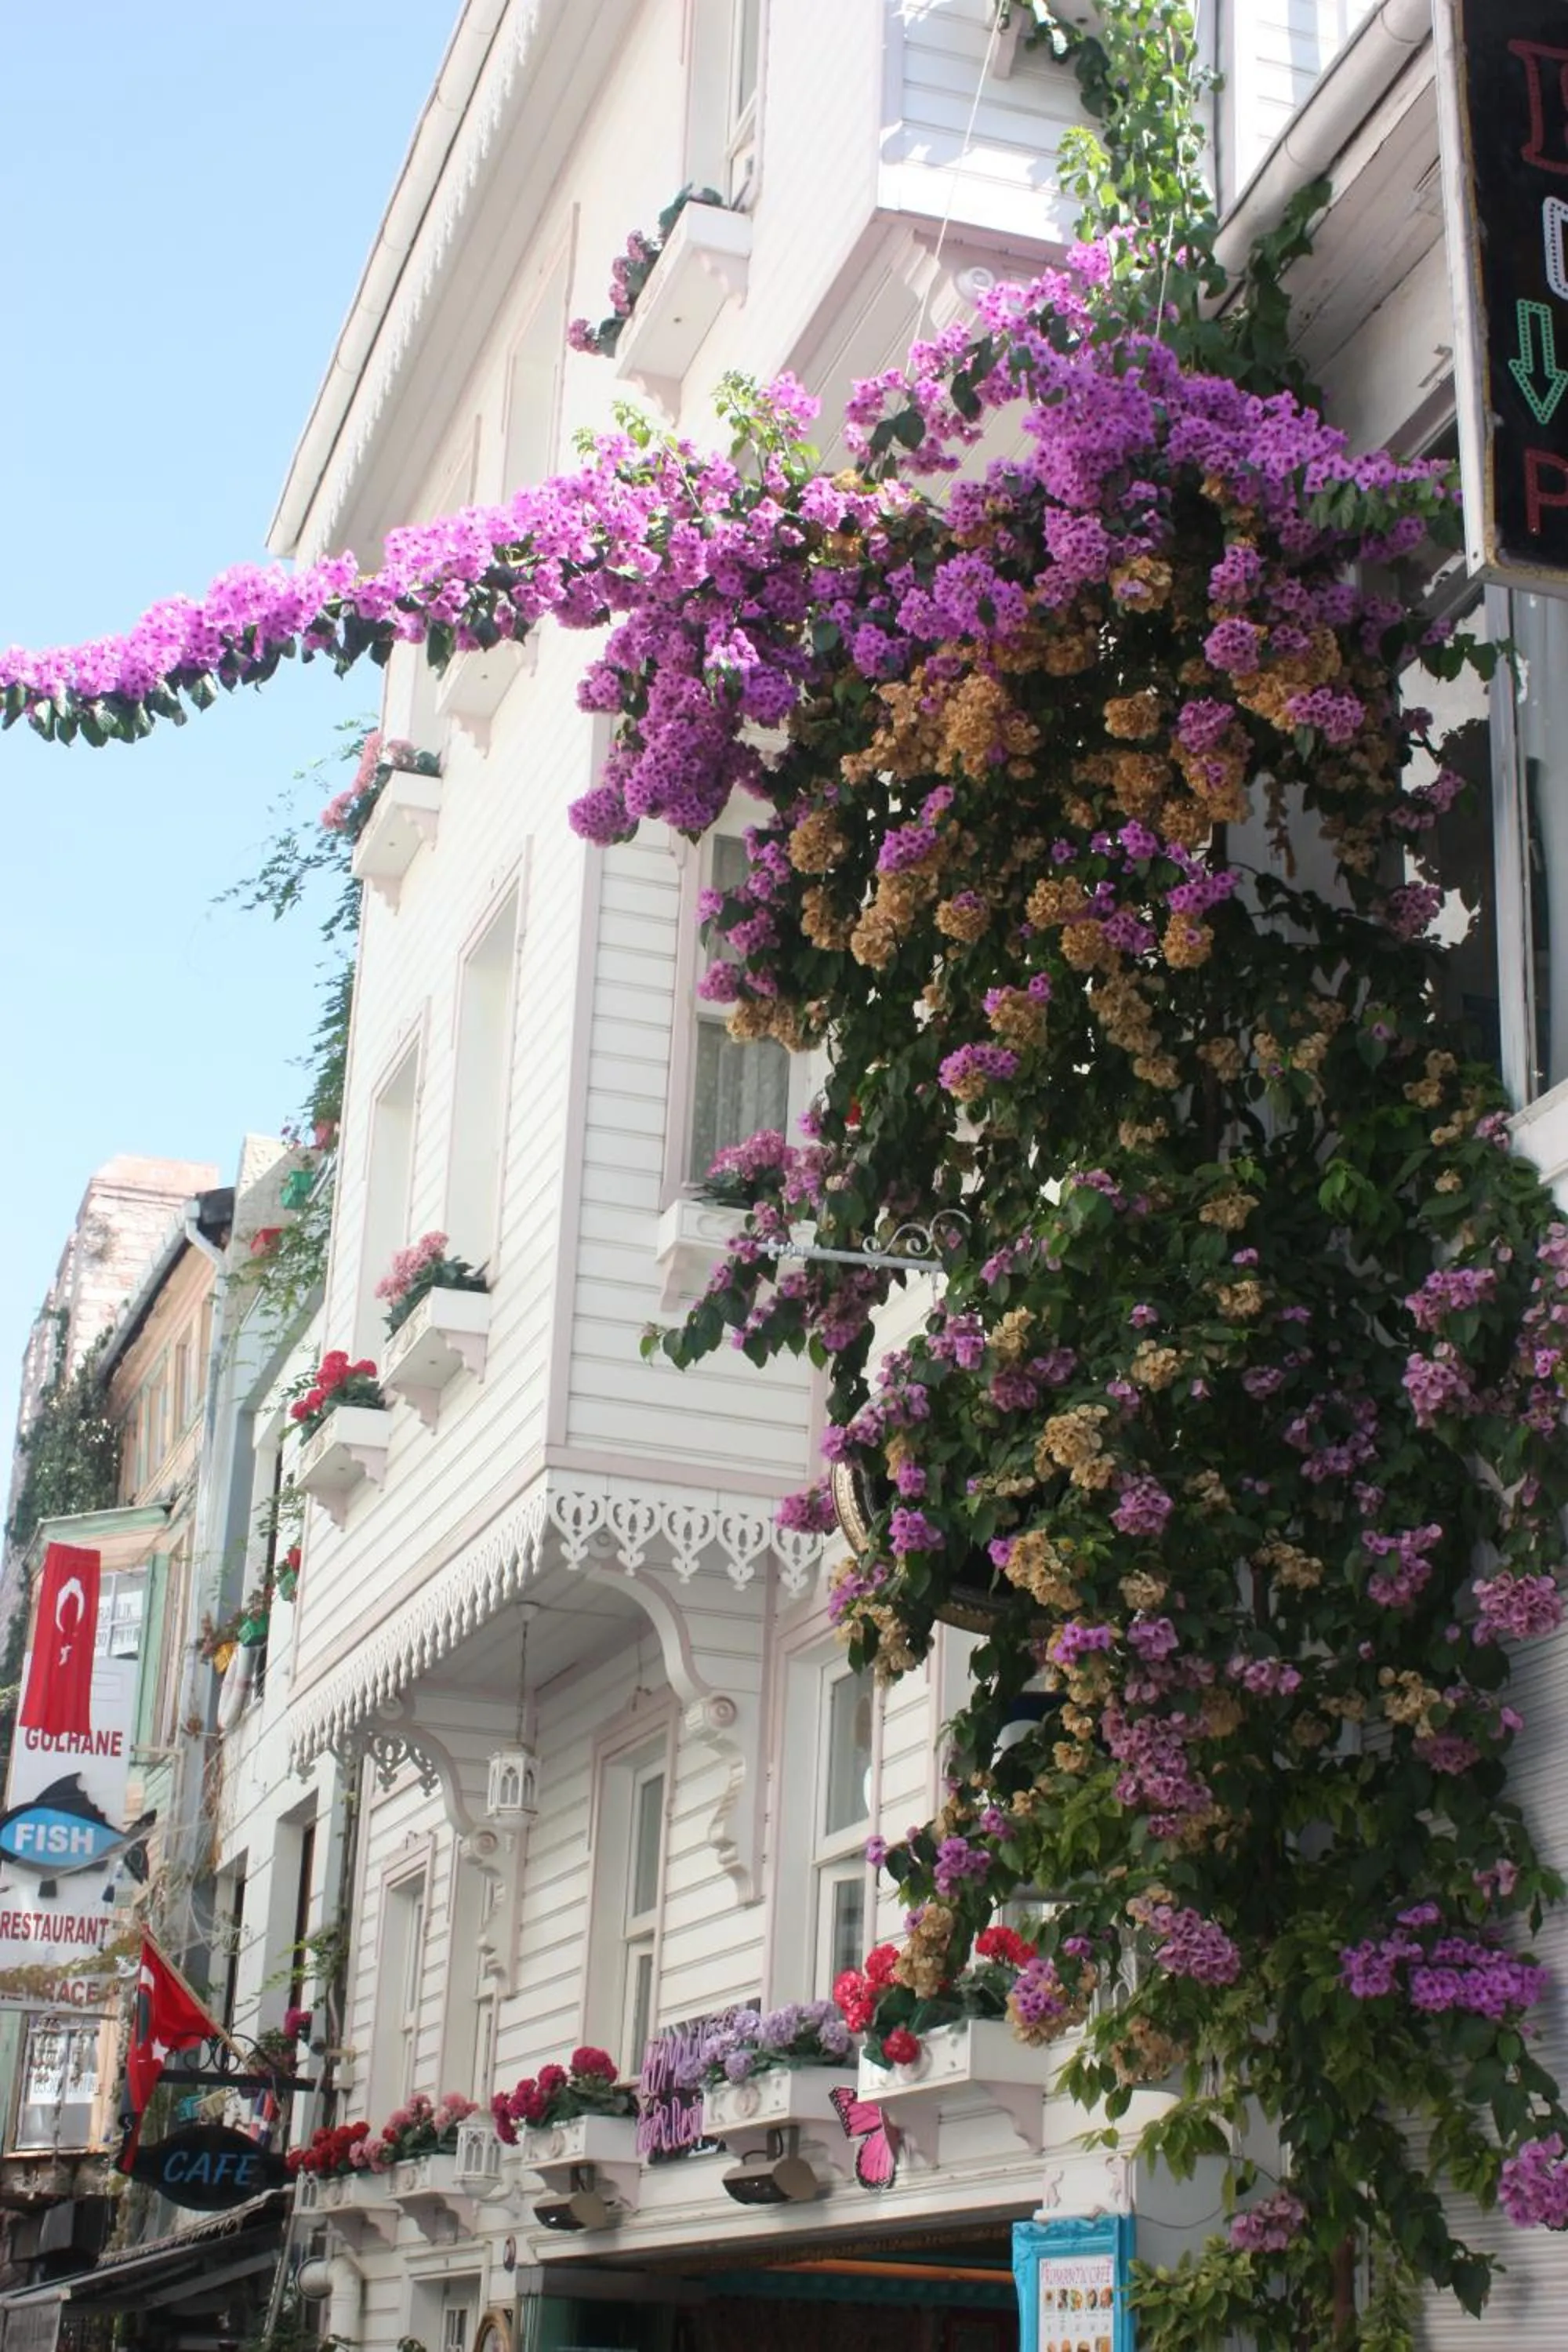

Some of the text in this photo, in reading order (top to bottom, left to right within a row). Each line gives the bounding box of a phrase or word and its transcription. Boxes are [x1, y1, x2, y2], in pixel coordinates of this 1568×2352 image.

[14, 1823, 95, 1854] FISH
[0, 1911, 110, 1945] RESTAURANT
[163, 2151, 258, 2186] CAFE
